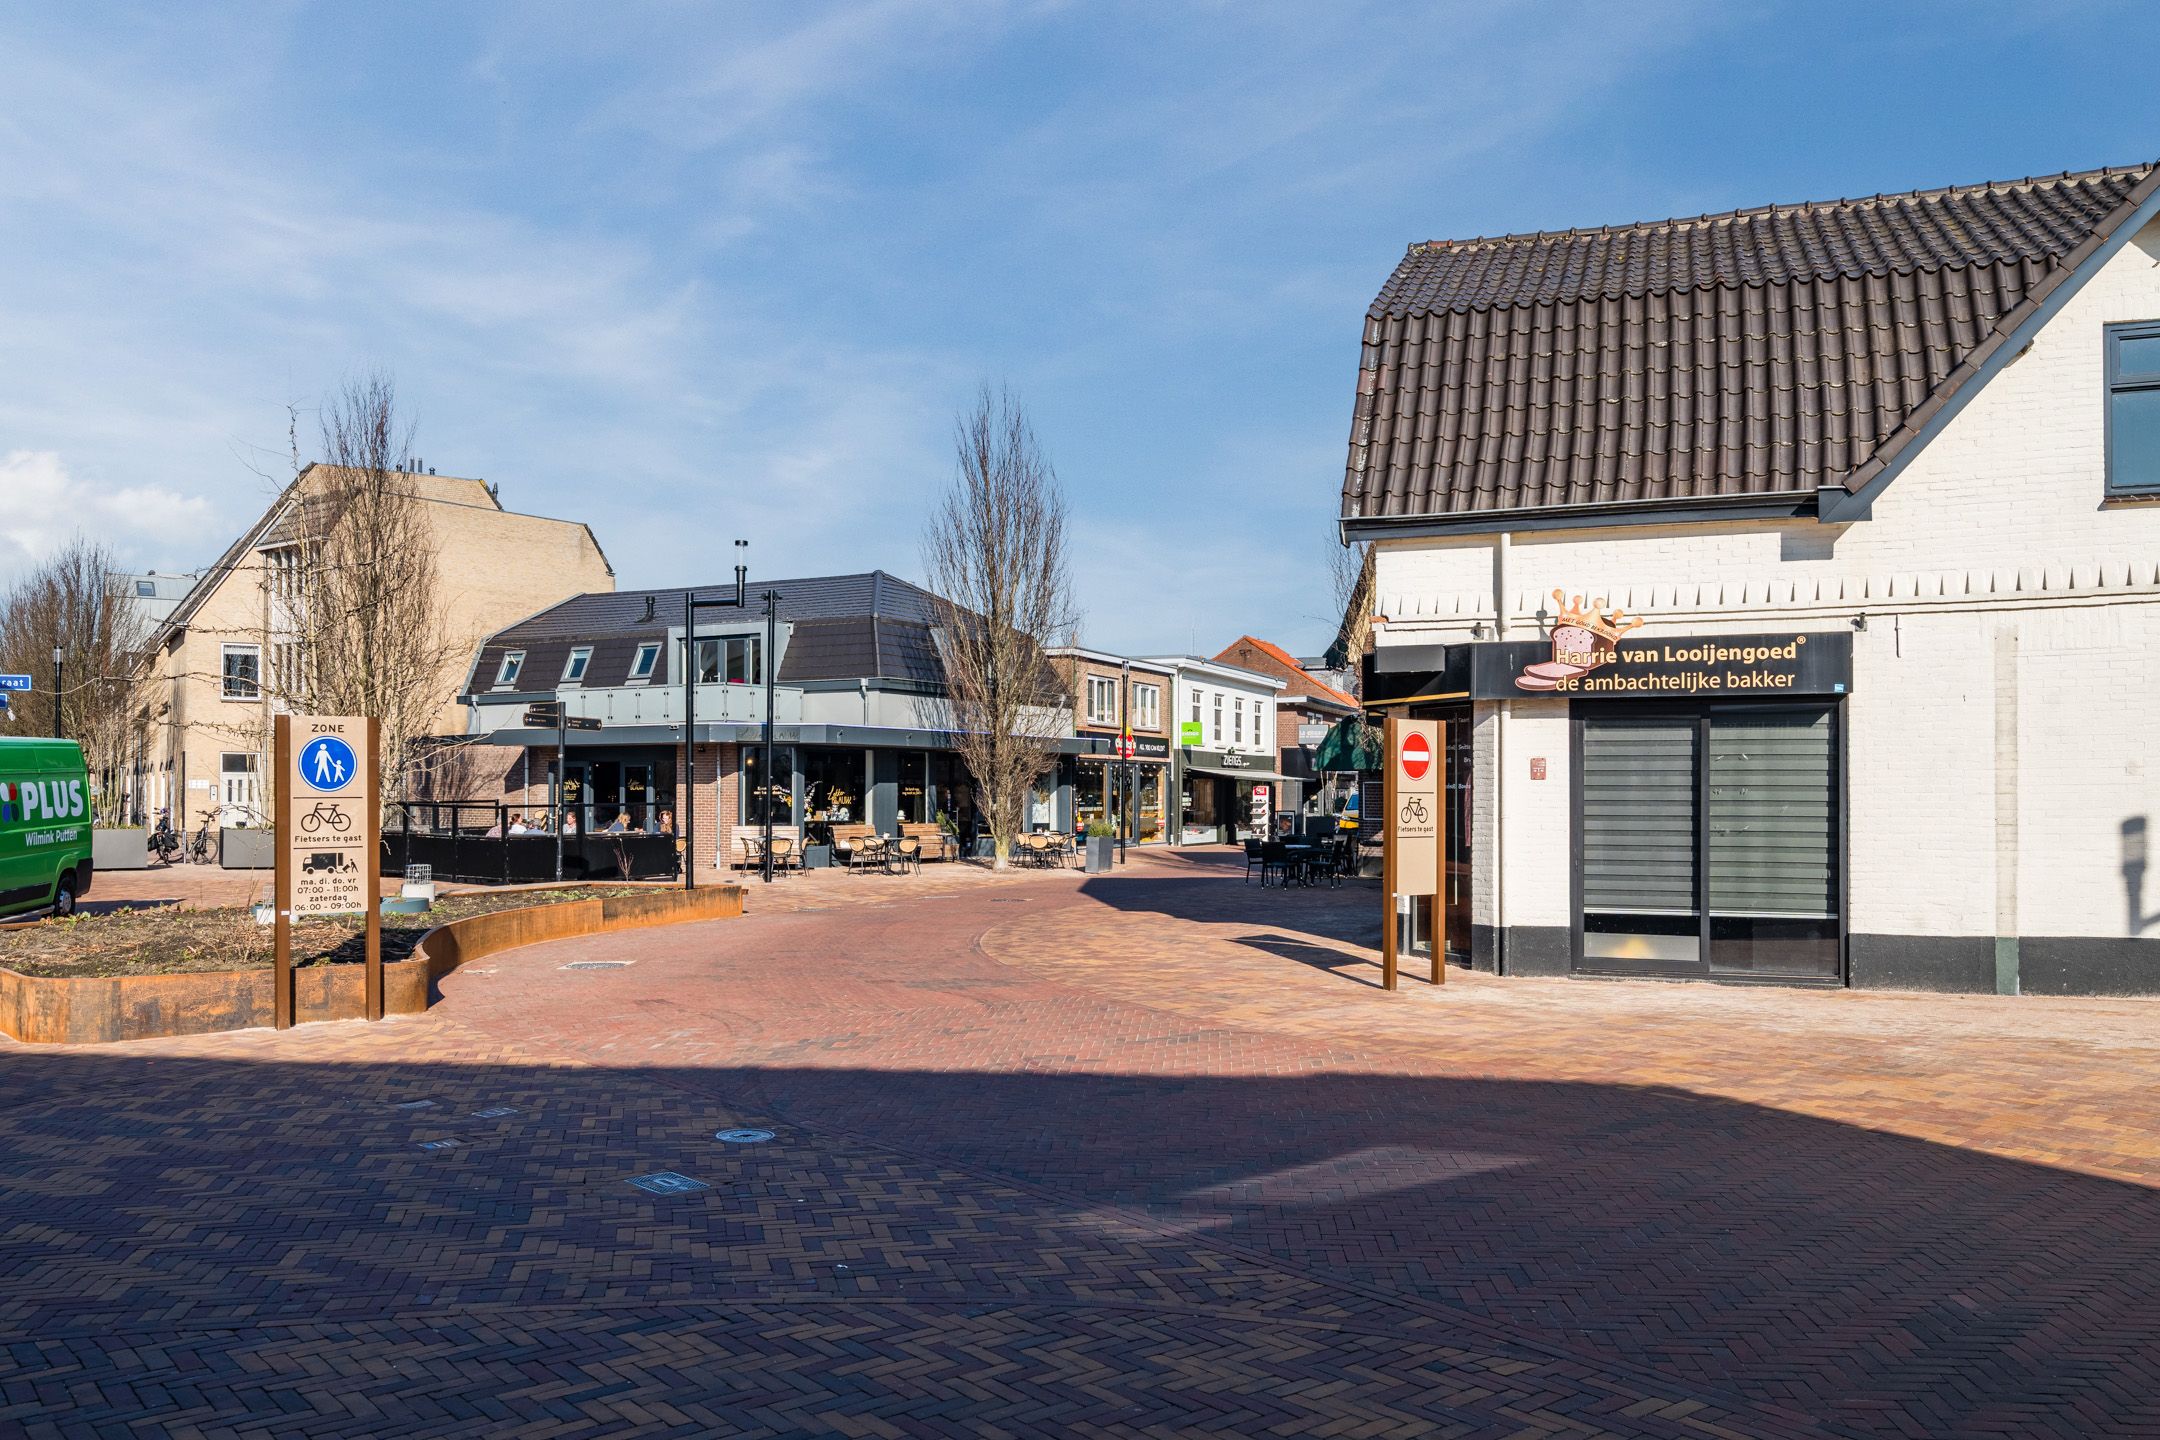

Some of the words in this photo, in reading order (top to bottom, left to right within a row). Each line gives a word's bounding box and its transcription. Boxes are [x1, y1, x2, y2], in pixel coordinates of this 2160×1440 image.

[1556, 647, 1618, 665] Harrie
[1622, 649, 1659, 663] van
[1555, 675, 1579, 692] de
[1584, 671, 1721, 694] ambachtelijke
[1726, 670, 1796, 689] bakker
[311, 723, 345, 733] ZONE
[21, 779, 84, 821] PLUS
[1397, 825, 1417, 833] Fietsers
[1423, 826, 1434, 834] gast
[25, 829, 55, 847] Wilmink
[55, 828, 78, 843] Putten
[294, 834, 330, 843] Fietsers
[343, 834, 362, 844] gast
[297, 886, 324, 894] 07:00
[333, 885, 359, 893] 11:00h
[309, 894, 348, 903] zaterdag
[294, 903, 322, 911] 06:00
[330, 901, 362, 910] 09:00h
